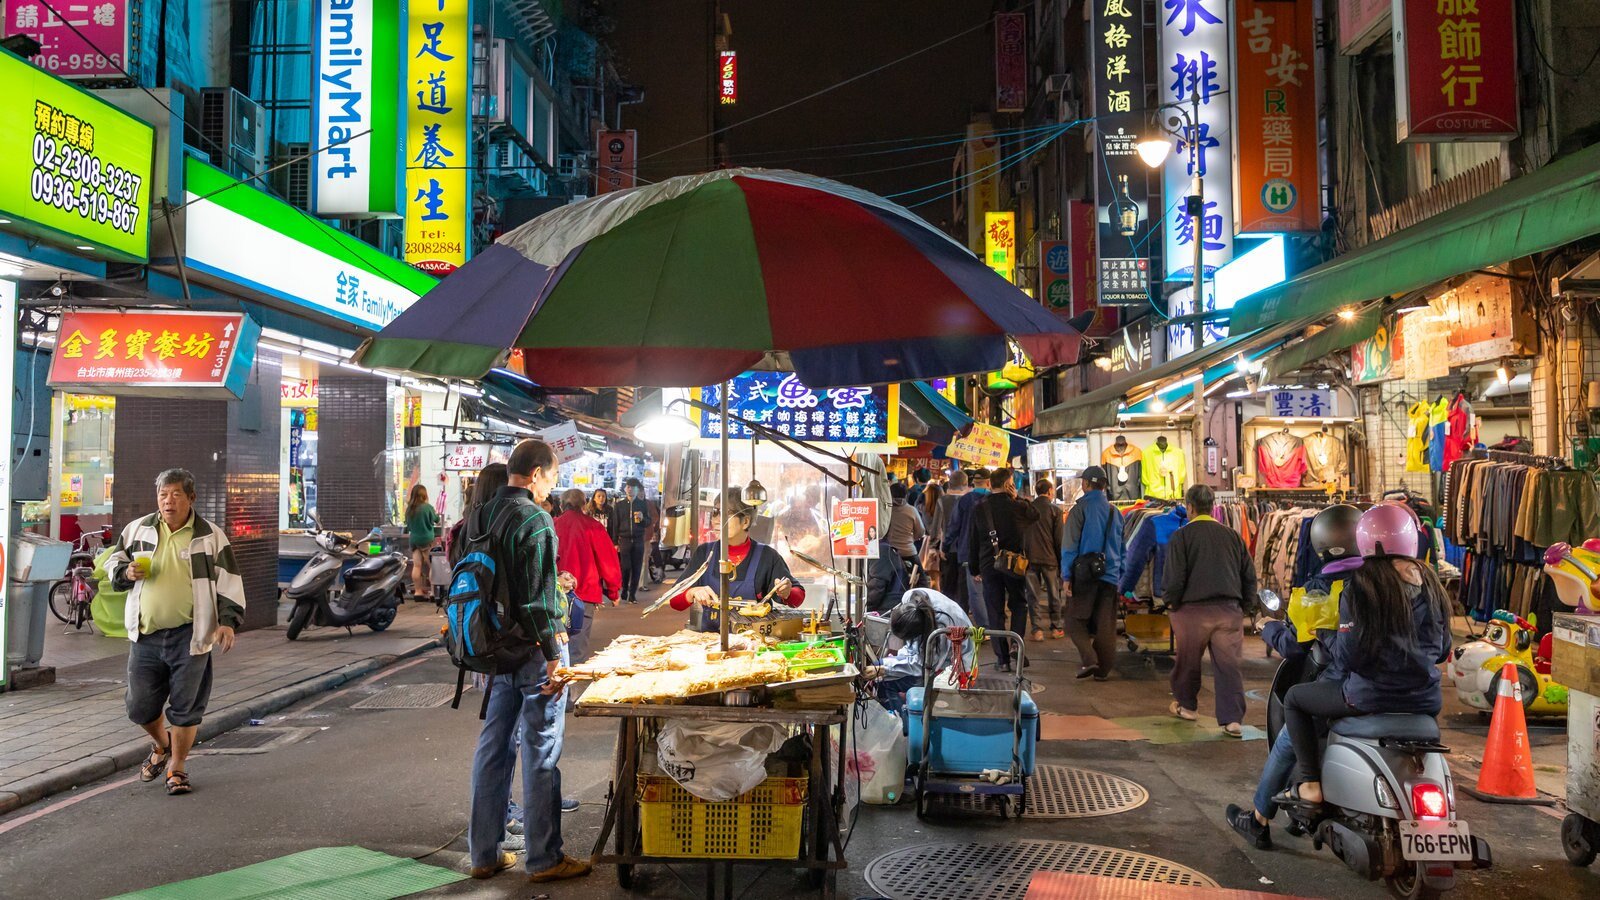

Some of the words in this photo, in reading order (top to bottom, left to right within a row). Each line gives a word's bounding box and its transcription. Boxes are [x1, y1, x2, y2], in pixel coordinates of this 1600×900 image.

[1103, 0, 1133, 113] 風格洋酒
[35, 100, 95, 151] 預約專線
[411, 0, 456, 222] 足道養生
[1436, 118, 1493, 129] COSTUME
[32, 133, 141, 204] 02-2308-3237
[31, 168, 139, 235] 0936-519-867
[405, 241, 462, 254] 23082884
[420, 230, 446, 239] Tel:
[336, 271, 359, 308] 全家
[60, 328, 216, 362] 金多寶餐坊
